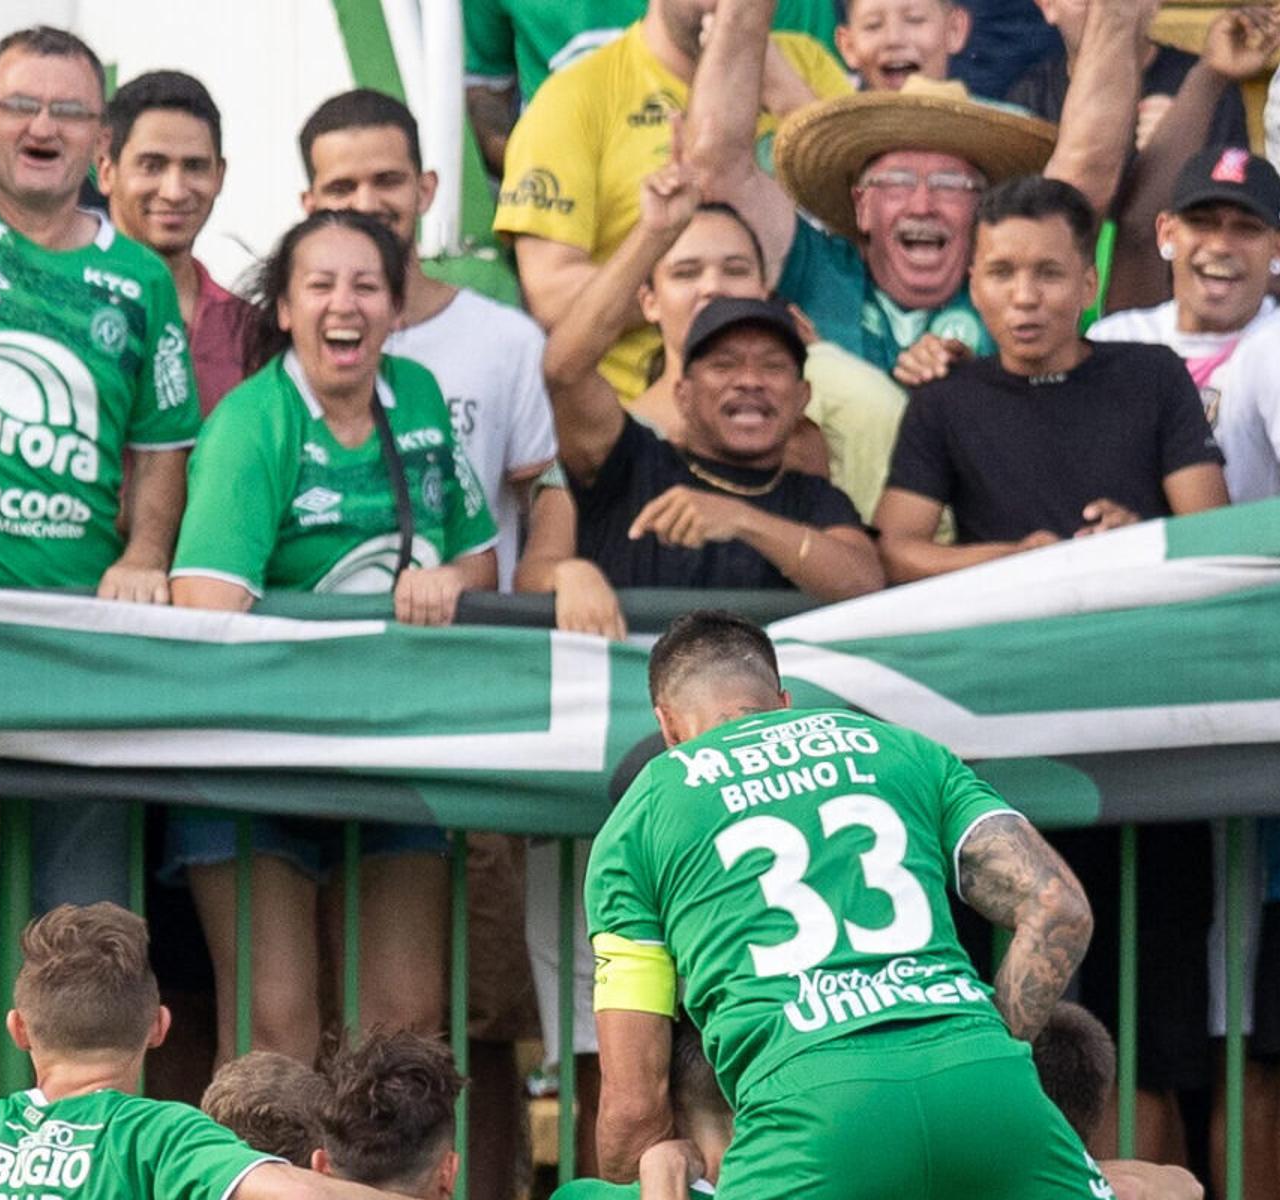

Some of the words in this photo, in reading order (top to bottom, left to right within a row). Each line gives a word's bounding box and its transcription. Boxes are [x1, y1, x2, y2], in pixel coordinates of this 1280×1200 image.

[83, 267, 142, 300] KTO
[396, 428, 444, 451] KTO
[760, 716, 837, 744] GRUPO
[729, 729, 880, 776] BUGIO
[720, 761, 839, 814] BRUNO
[844, 757, 876, 784] L.
[714, 793, 934, 978] 33
